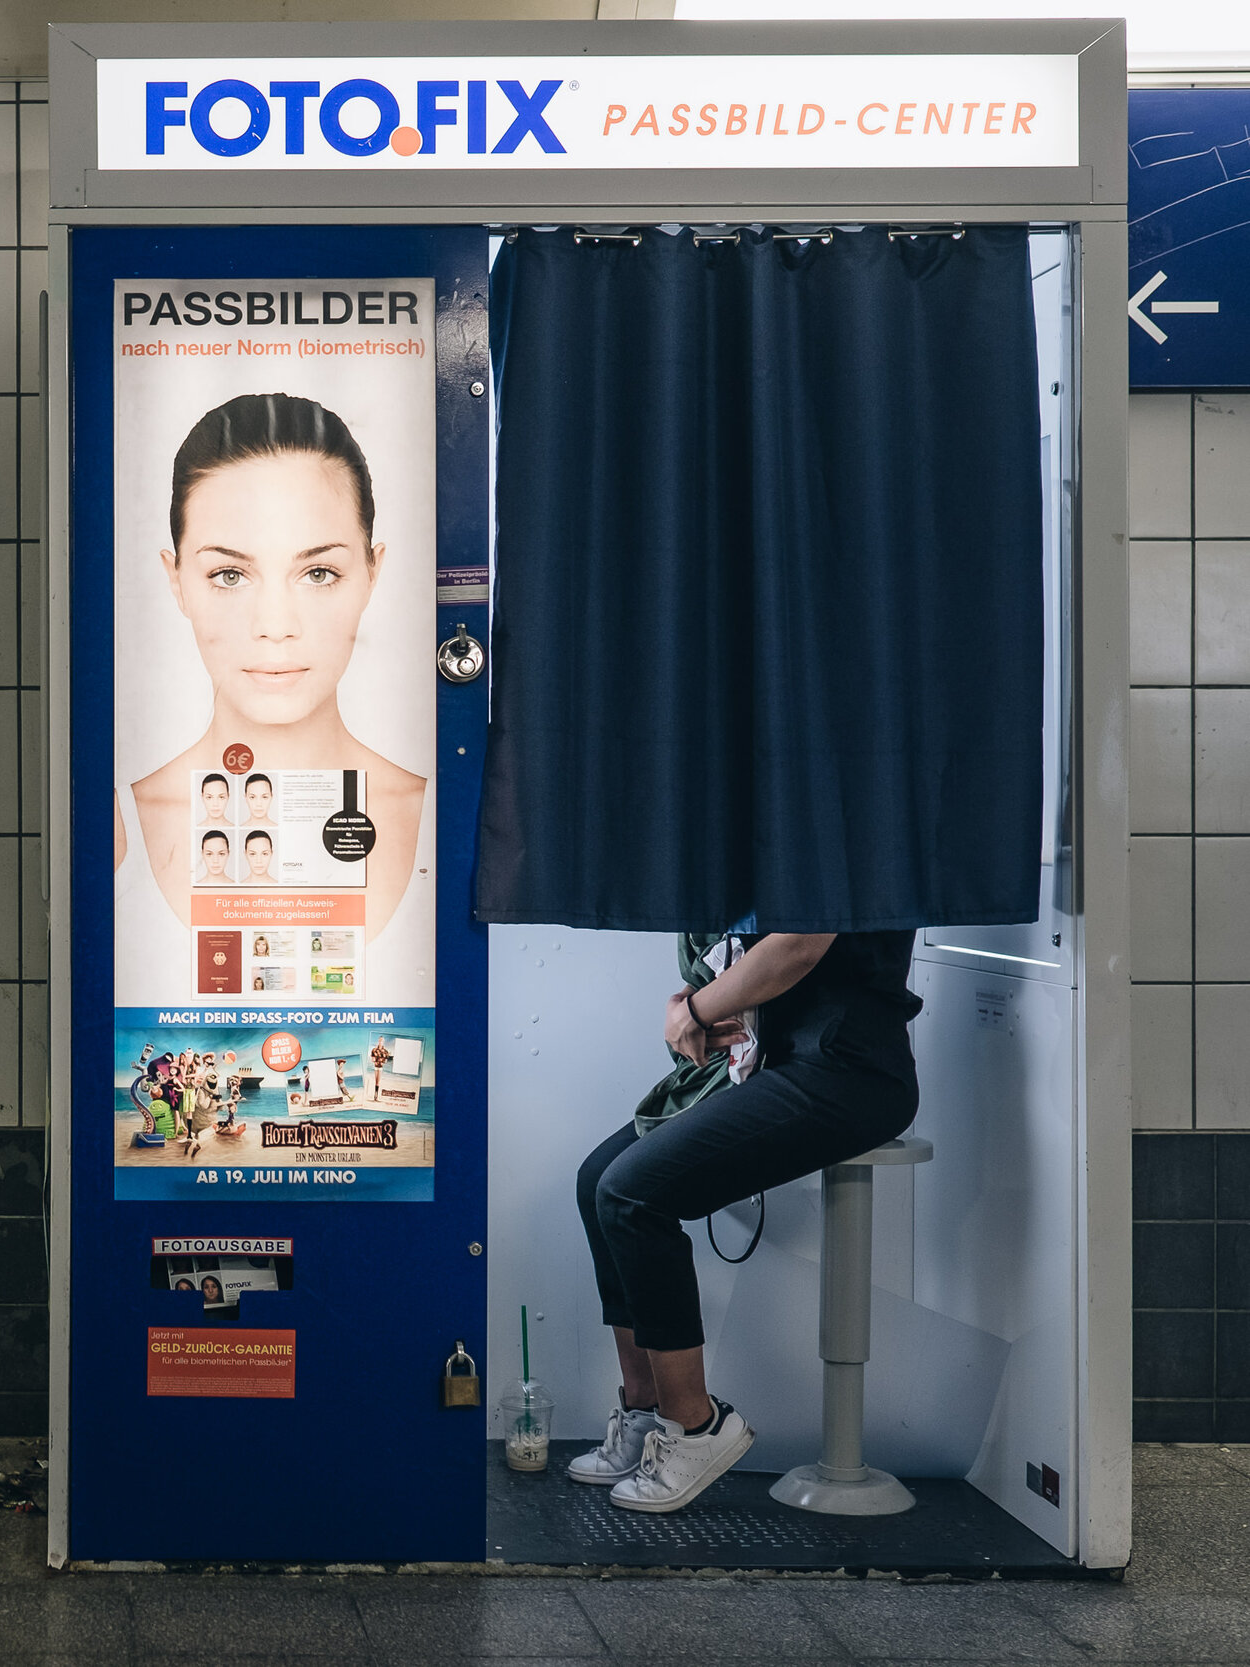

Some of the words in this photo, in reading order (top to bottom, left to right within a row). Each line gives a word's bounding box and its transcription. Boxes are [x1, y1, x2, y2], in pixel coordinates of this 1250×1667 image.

[602, 102, 1037, 137] PASSBILD-CENTER
[123, 290, 419, 326] PASSBILDER
[121, 339, 168, 356] nach
[175, 342, 232, 356] neuer
[237, 339, 292, 356] Norm
[297, 338, 426, 359] (biometrisch)
[215, 898, 231, 908] Für
[233, 898, 250, 908] alle
[252, 898, 295, 908] offiziellen
[223, 910, 274, 919] dokumente
[275, 910, 330, 921] zugelassen!
[158, 1012, 200, 1024] MACH
[204, 1012, 236, 1024] DEIN
[241, 1012, 324, 1024] SPASS-FOTO
[328, 1012, 360, 1024] ZUM
[363, 1012, 395, 1024] FILM
[265, 1124, 301, 1145] HOTEL
[301, 1124, 383, 1147] TRANSSILVANIEN
[383, 1123, 393, 1146] 3
[196, 1170, 218, 1183] AB
[225, 1170, 246, 1183] 19.
[251, 1170, 283, 1183] JULI
[288, 1170, 308, 1183] IM
[313, 1170, 357, 1183] KINO
[161, 1240, 286, 1252] FOTOAUSGABE
[150, 1341, 293, 1355] GELD-ZURÜCK-GARANTIE
[174, 1357, 189, 1365] alle
[190, 1357, 248, 1366] biometrischen
